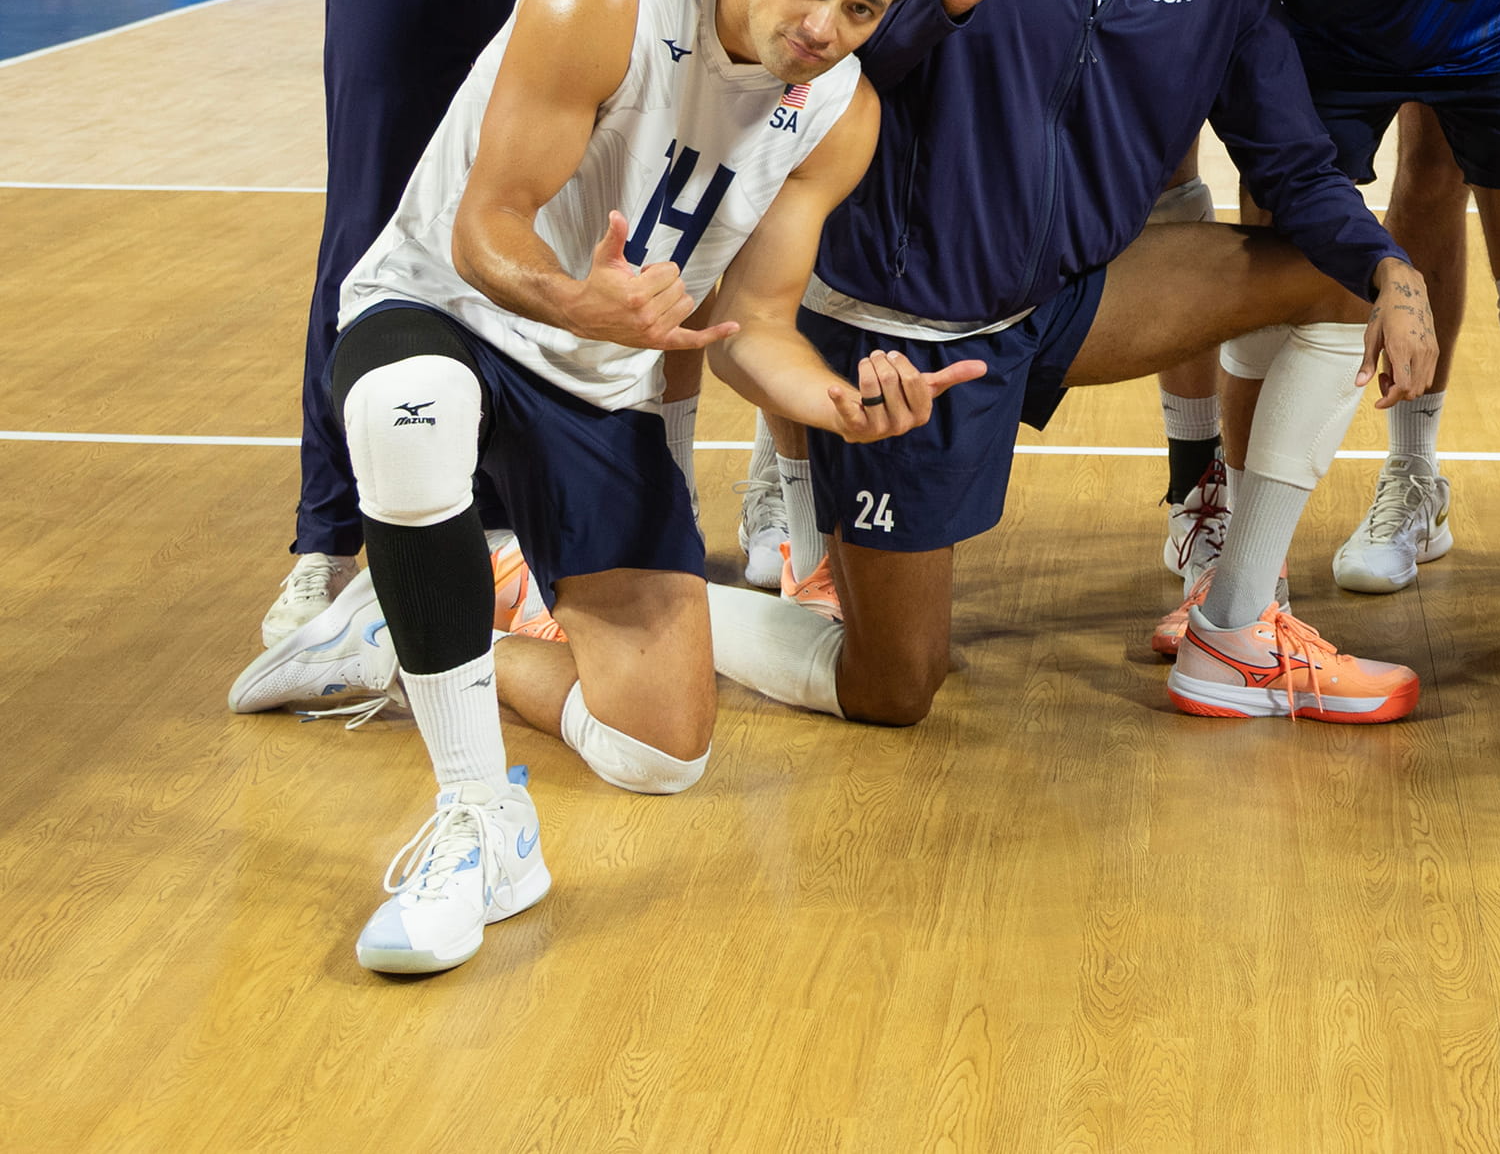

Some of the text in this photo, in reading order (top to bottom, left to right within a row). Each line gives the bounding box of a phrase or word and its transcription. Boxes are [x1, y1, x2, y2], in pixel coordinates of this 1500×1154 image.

[769, 106, 798, 133] SA
[623, 139, 736, 276] 14
[854, 489, 895, 533] 24
